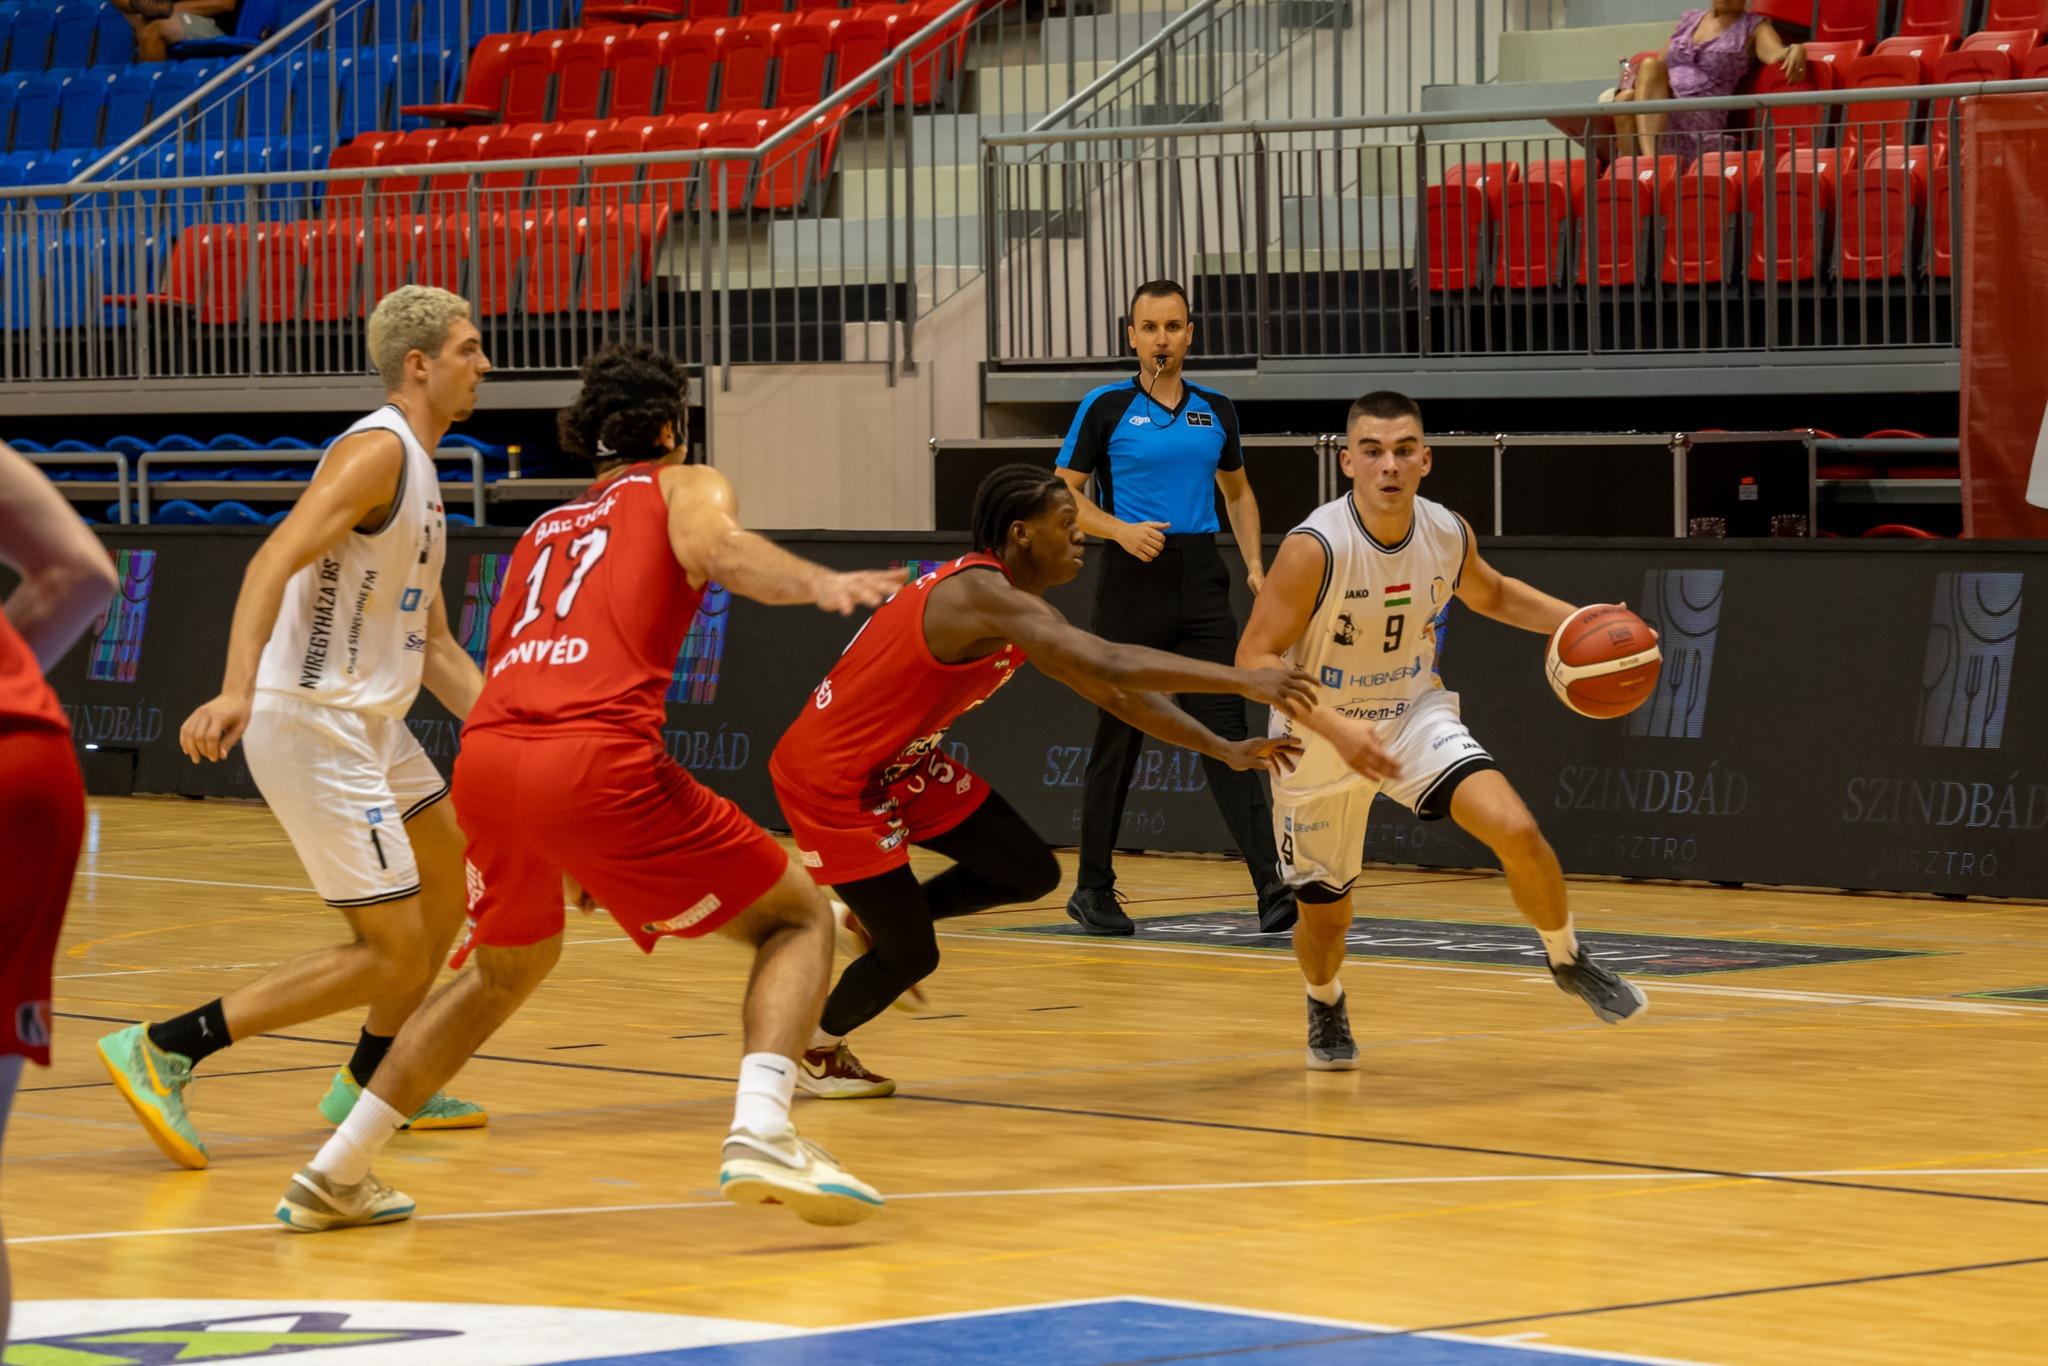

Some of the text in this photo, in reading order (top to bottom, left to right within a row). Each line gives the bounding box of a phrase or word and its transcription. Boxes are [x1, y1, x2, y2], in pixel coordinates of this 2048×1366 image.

[363, 569, 379, 592] FM
[511, 526, 610, 638] 17
[1344, 589, 1370, 600] JAKO
[1383, 614, 1405, 653] 9
[1554, 759, 1750, 817] SZINDBÁD
[1842, 769, 2048, 831] SZINDBÁD
[1281, 831, 1295, 865] 9
